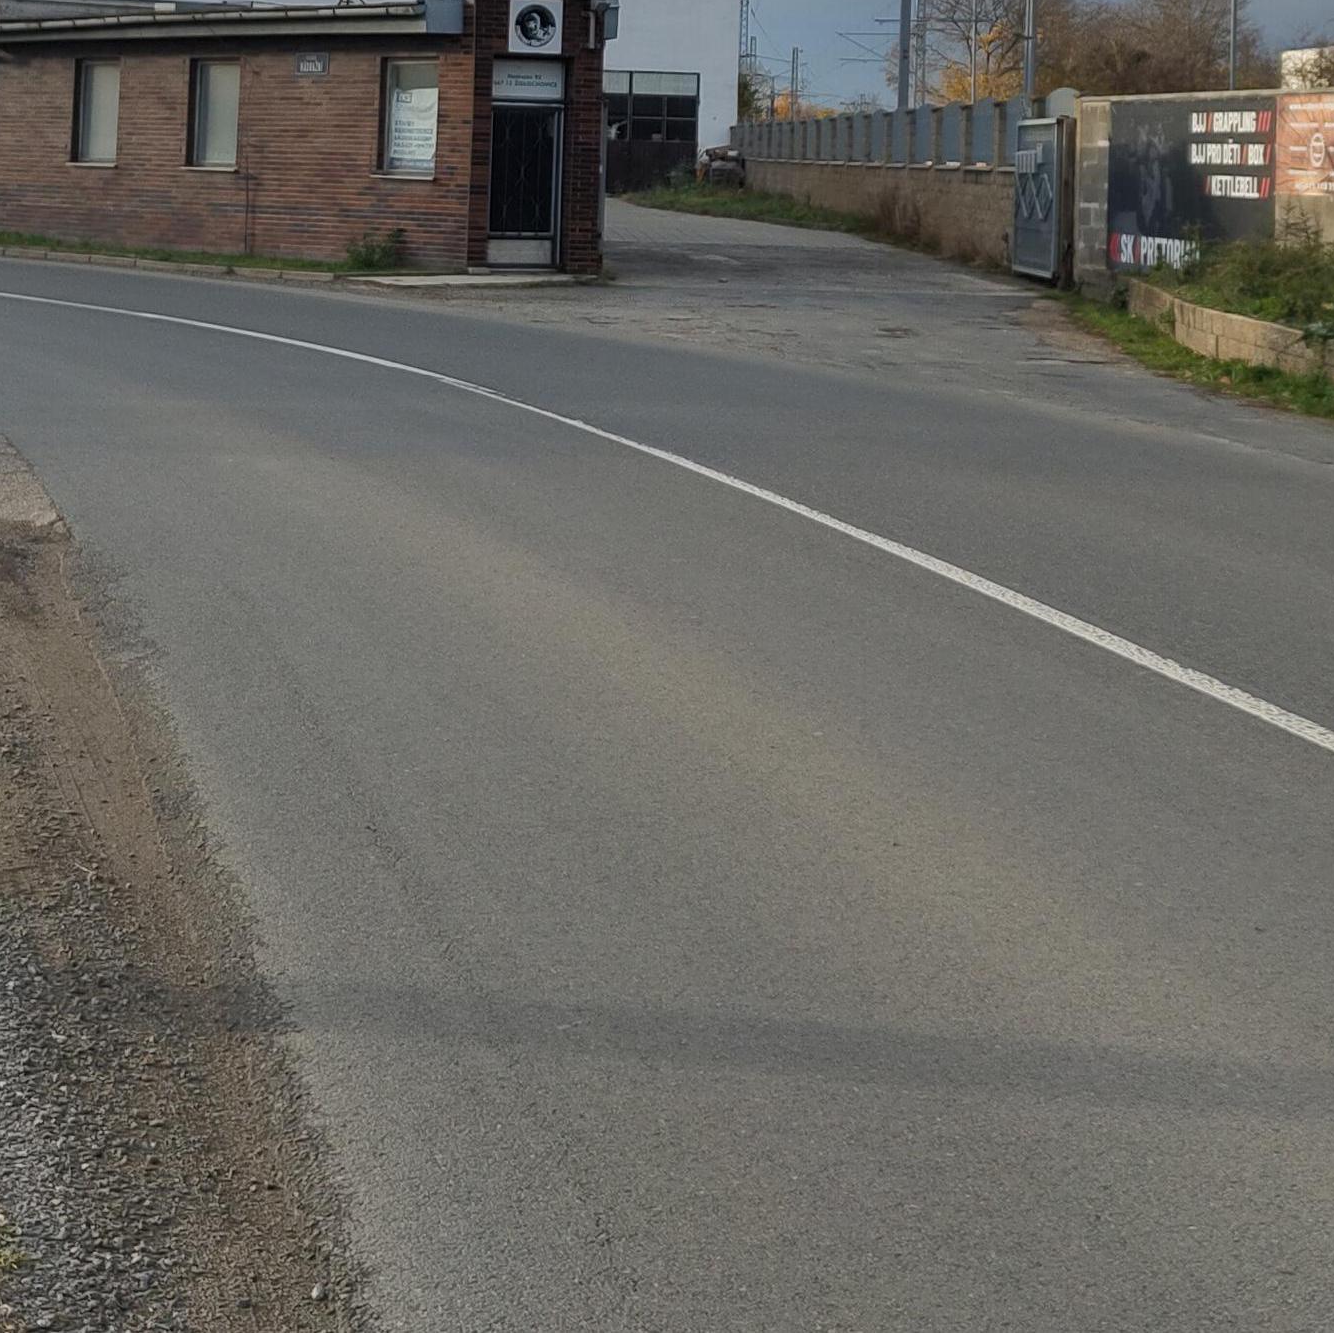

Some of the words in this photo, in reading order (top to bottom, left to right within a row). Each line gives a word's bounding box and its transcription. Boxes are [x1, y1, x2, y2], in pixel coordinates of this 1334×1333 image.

[1213, 111, 1257, 133] GRAPPLING
[1207, 143, 1222, 164] PRO
[1223, 138, 1241, 165] DĚTI
[1248, 144, 1265, 165] BOX
[1211, 175, 1260, 199] KETTLEBELL
[1120, 233, 1134, 264] SK
